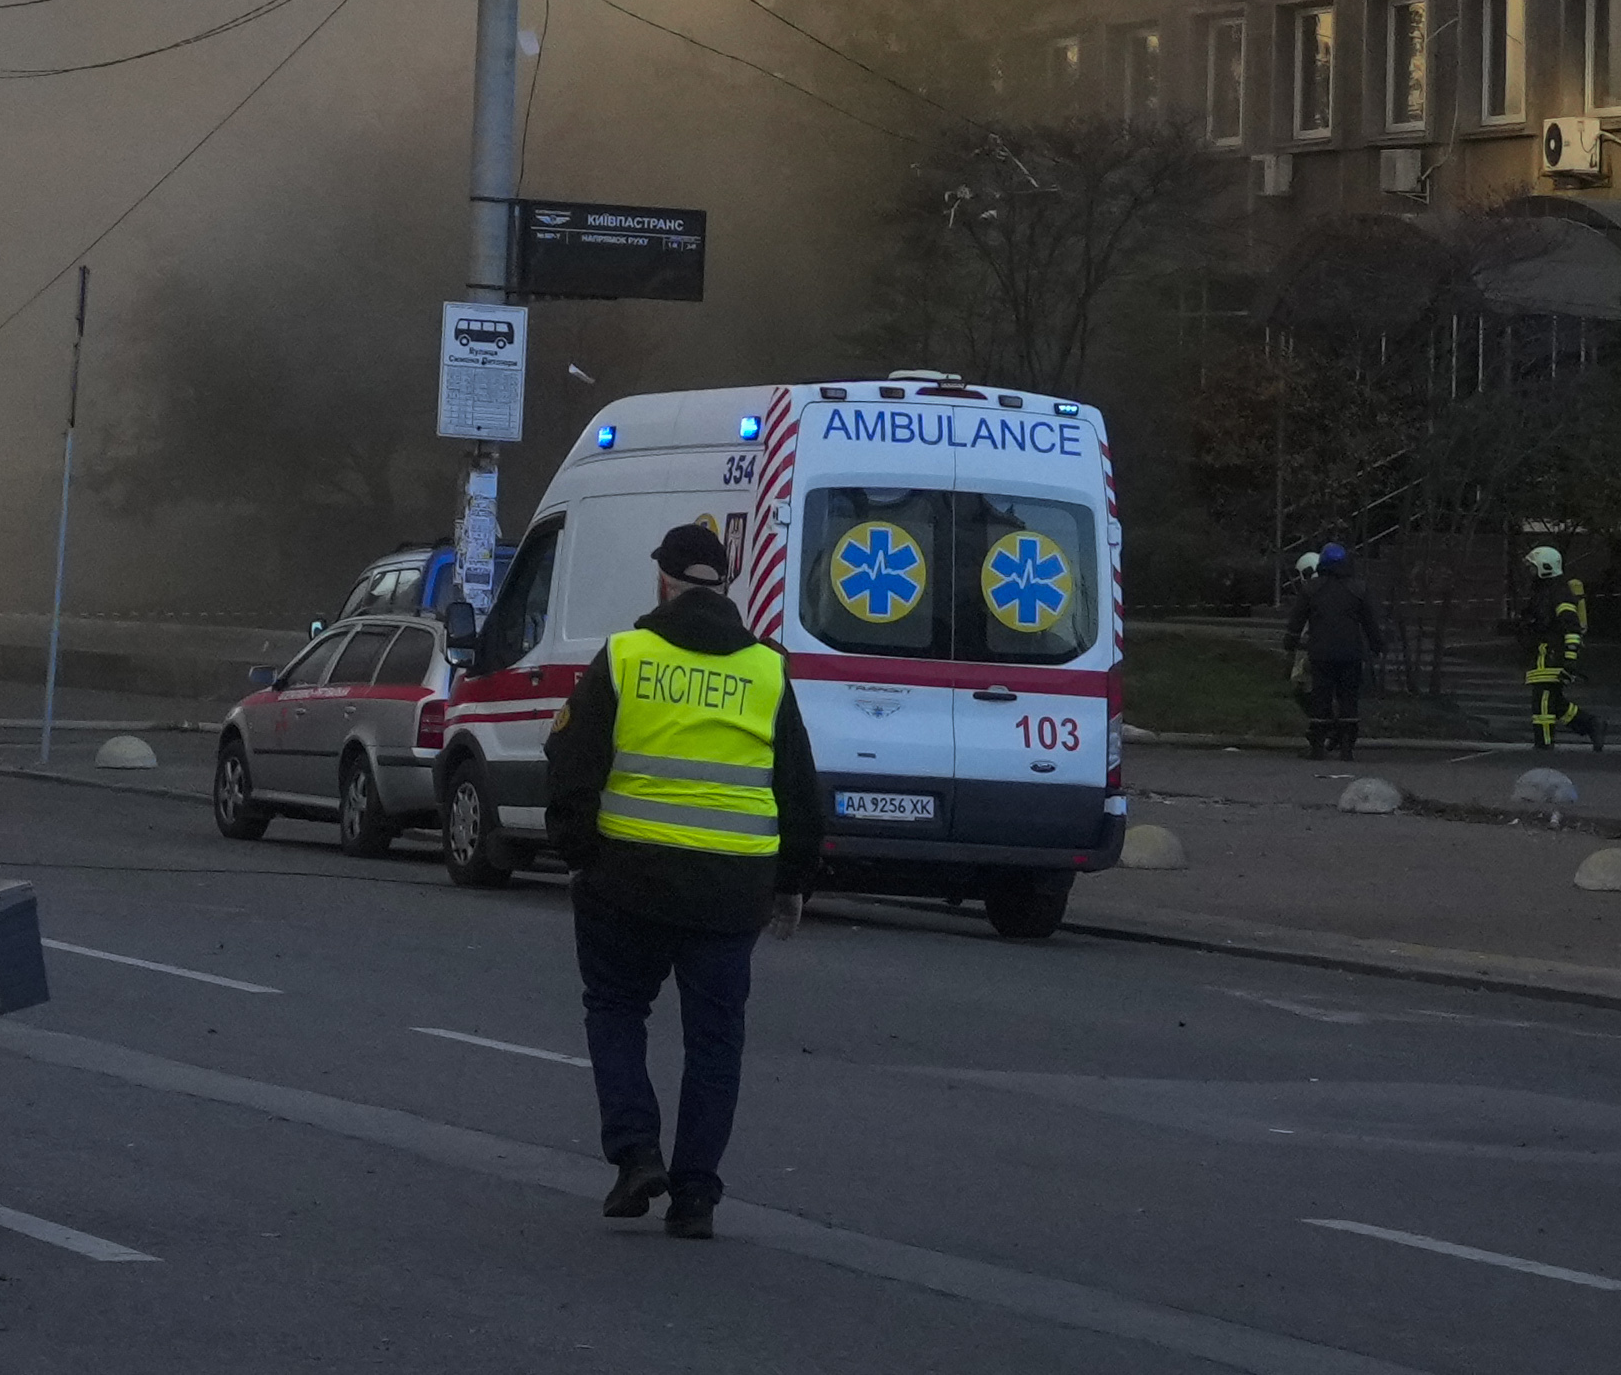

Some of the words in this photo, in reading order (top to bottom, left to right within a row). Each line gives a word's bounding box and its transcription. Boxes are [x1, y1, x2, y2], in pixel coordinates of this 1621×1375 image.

[587, 213, 685, 232] КИЇВПАСТРАНС
[823, 408, 1082, 457] AMBULANCE
[723, 455, 756, 485] 354
[636, 659, 753, 716] ЕКСПЕРТ
[1015, 715, 1081, 752] 103
[846, 797, 869, 813] AA
[871, 797, 906, 815] 9256
[910, 799, 931, 815] XK
